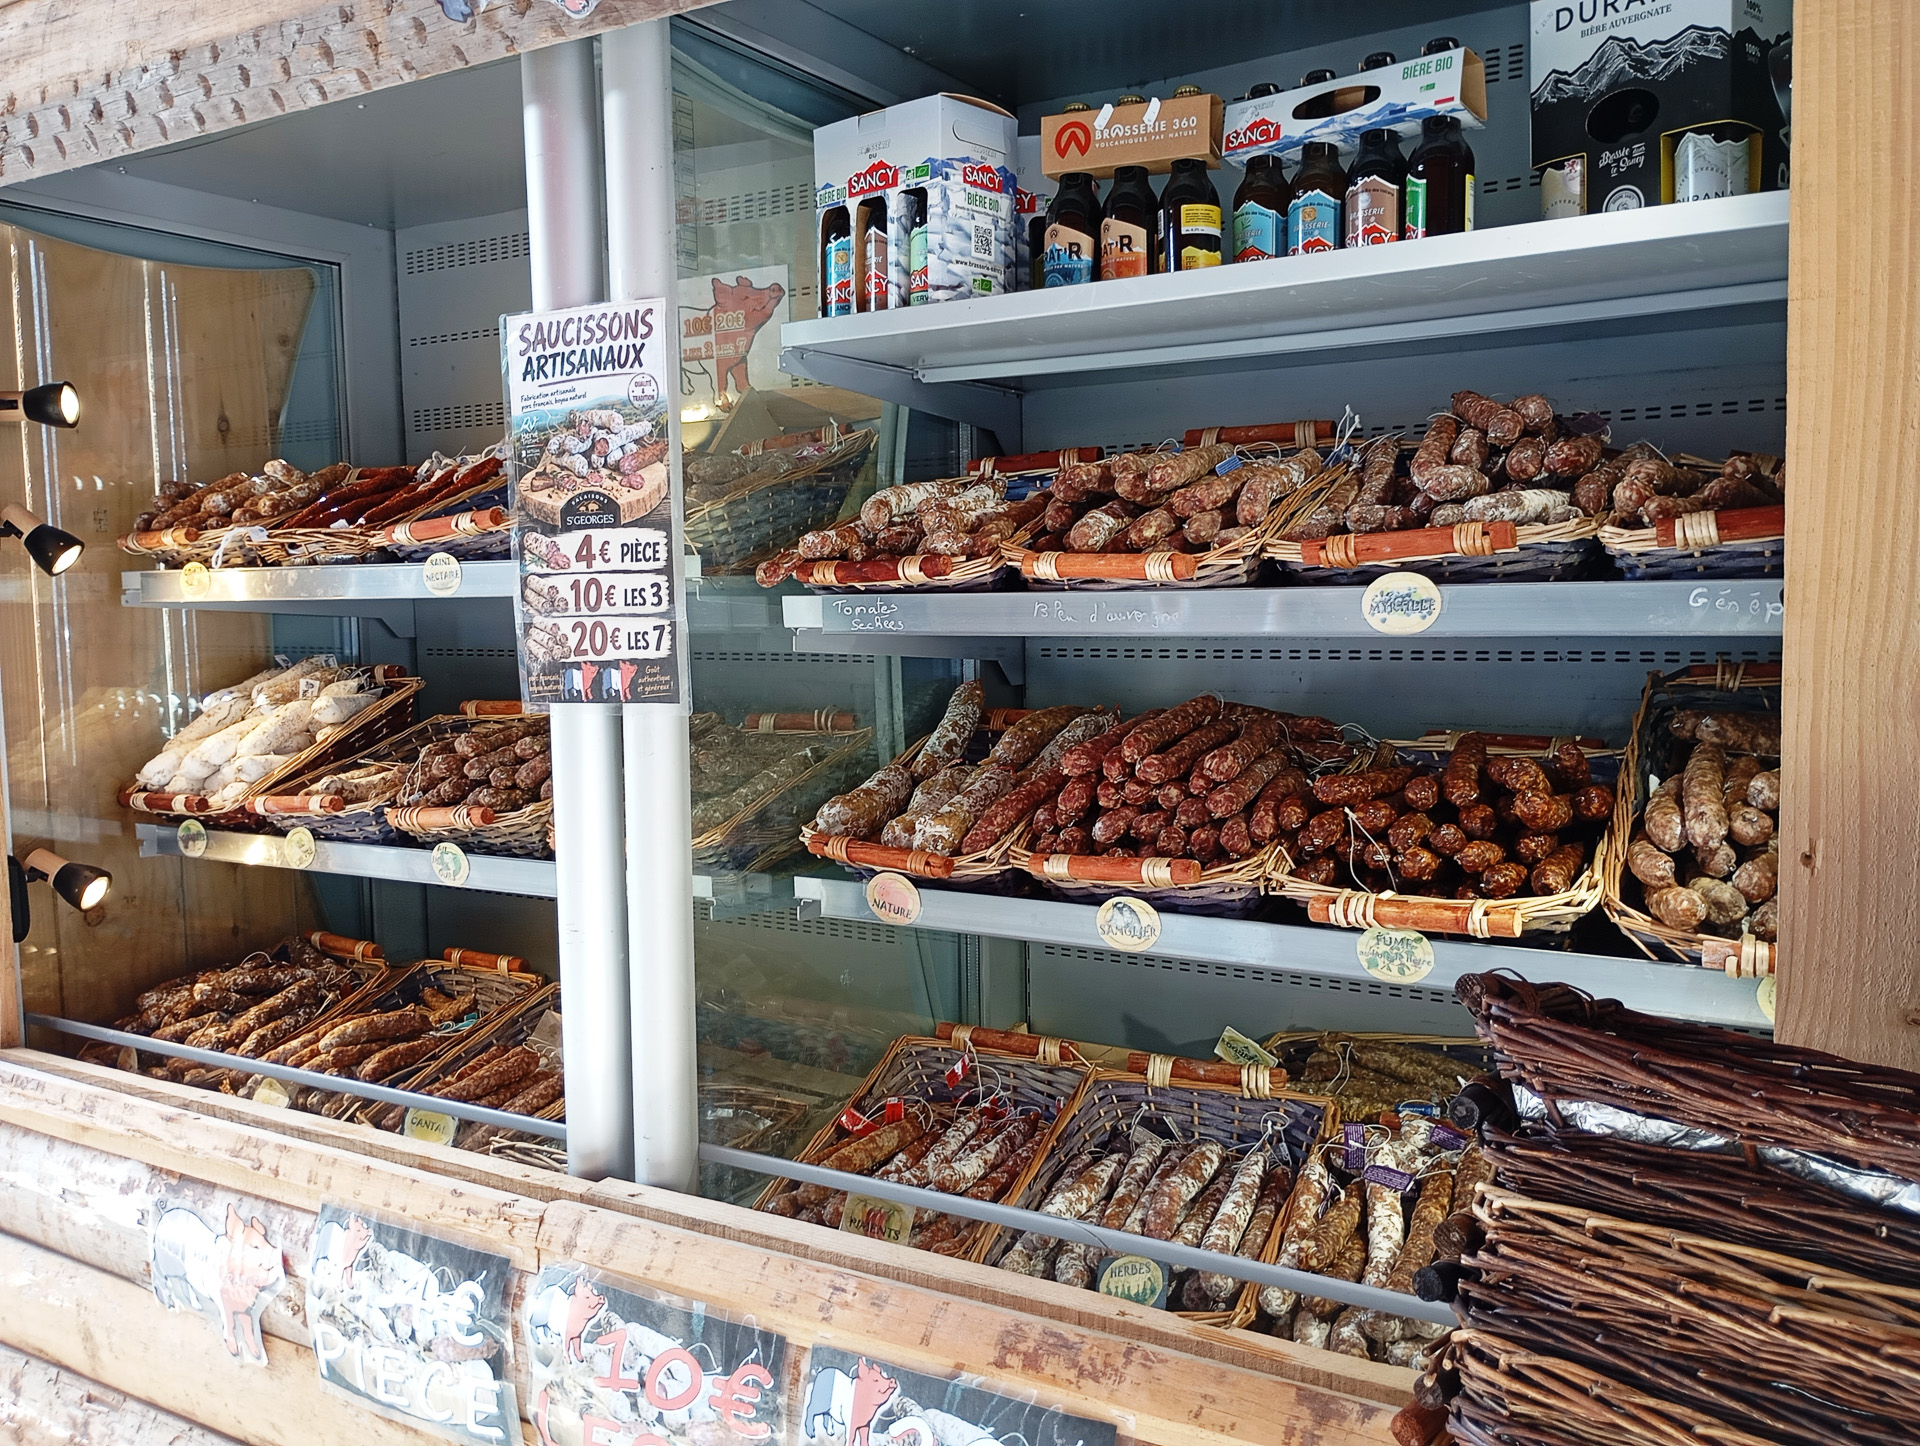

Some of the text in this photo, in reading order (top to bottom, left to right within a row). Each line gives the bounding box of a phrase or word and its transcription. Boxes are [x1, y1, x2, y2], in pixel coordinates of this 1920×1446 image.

[1580, 22, 1608, 39] BIÈRE
[1608, 3, 1673, 30] AUVERGNATE
[1402, 55, 1453, 81] BIÈRE BIO
[1095, 115, 1197, 141] BRASSERIE 360
[1229, 123, 1277, 148] SANCY
[1095, 136, 1148, 149] VOLCANIQUES
[1168, 129, 1197, 139] NATURE
[868, 152, 877, 160] DU
[851, 166, 895, 194] SANCY
[965, 167, 1000, 190] SANCY
[818, 186, 847, 206] BIÈRE BIO
[967, 192, 988, 210] BIÈRE
[988, 197, 1000, 213] BIO
[684, 315, 713, 335] 10€
[716, 311, 745, 331] 20€
[518, 307, 654, 357] SAUCISSONS
[703, 341, 714, 359] 3
[736, 337, 747, 354] 7
[521, 342, 646, 382] ARTISANAUX
[520, 385, 577, 403] Fabrication artisanale
[571, 493, 608, 506] SALAISONS
[620, 537, 661, 563] PIÈCE
[429, 556, 451, 566] SAINT
[425, 569, 461, 582] NECTAIRE
[570, 577, 663, 613] 10€ LES 3
[1688, 586, 1784, 624] Génép
[832, 596, 898, 616] Tomates
[1368, 597, 1437, 616] MYRTILLE
[571, 620, 666, 657] 20€ LES 7
[637, 673, 672, 685] authentique
[645, 665, 661, 674] Goût
[871, 898, 913, 920] NATURE
[1099, 923, 1158, 940] SANGLIER
[410, 1116, 447, 1135] CANTAL
[1109, 1260, 1152, 1279] HERBES
[313, 1322, 505, 1439] PIECE
[594, 1328, 775, 1439] 10€
